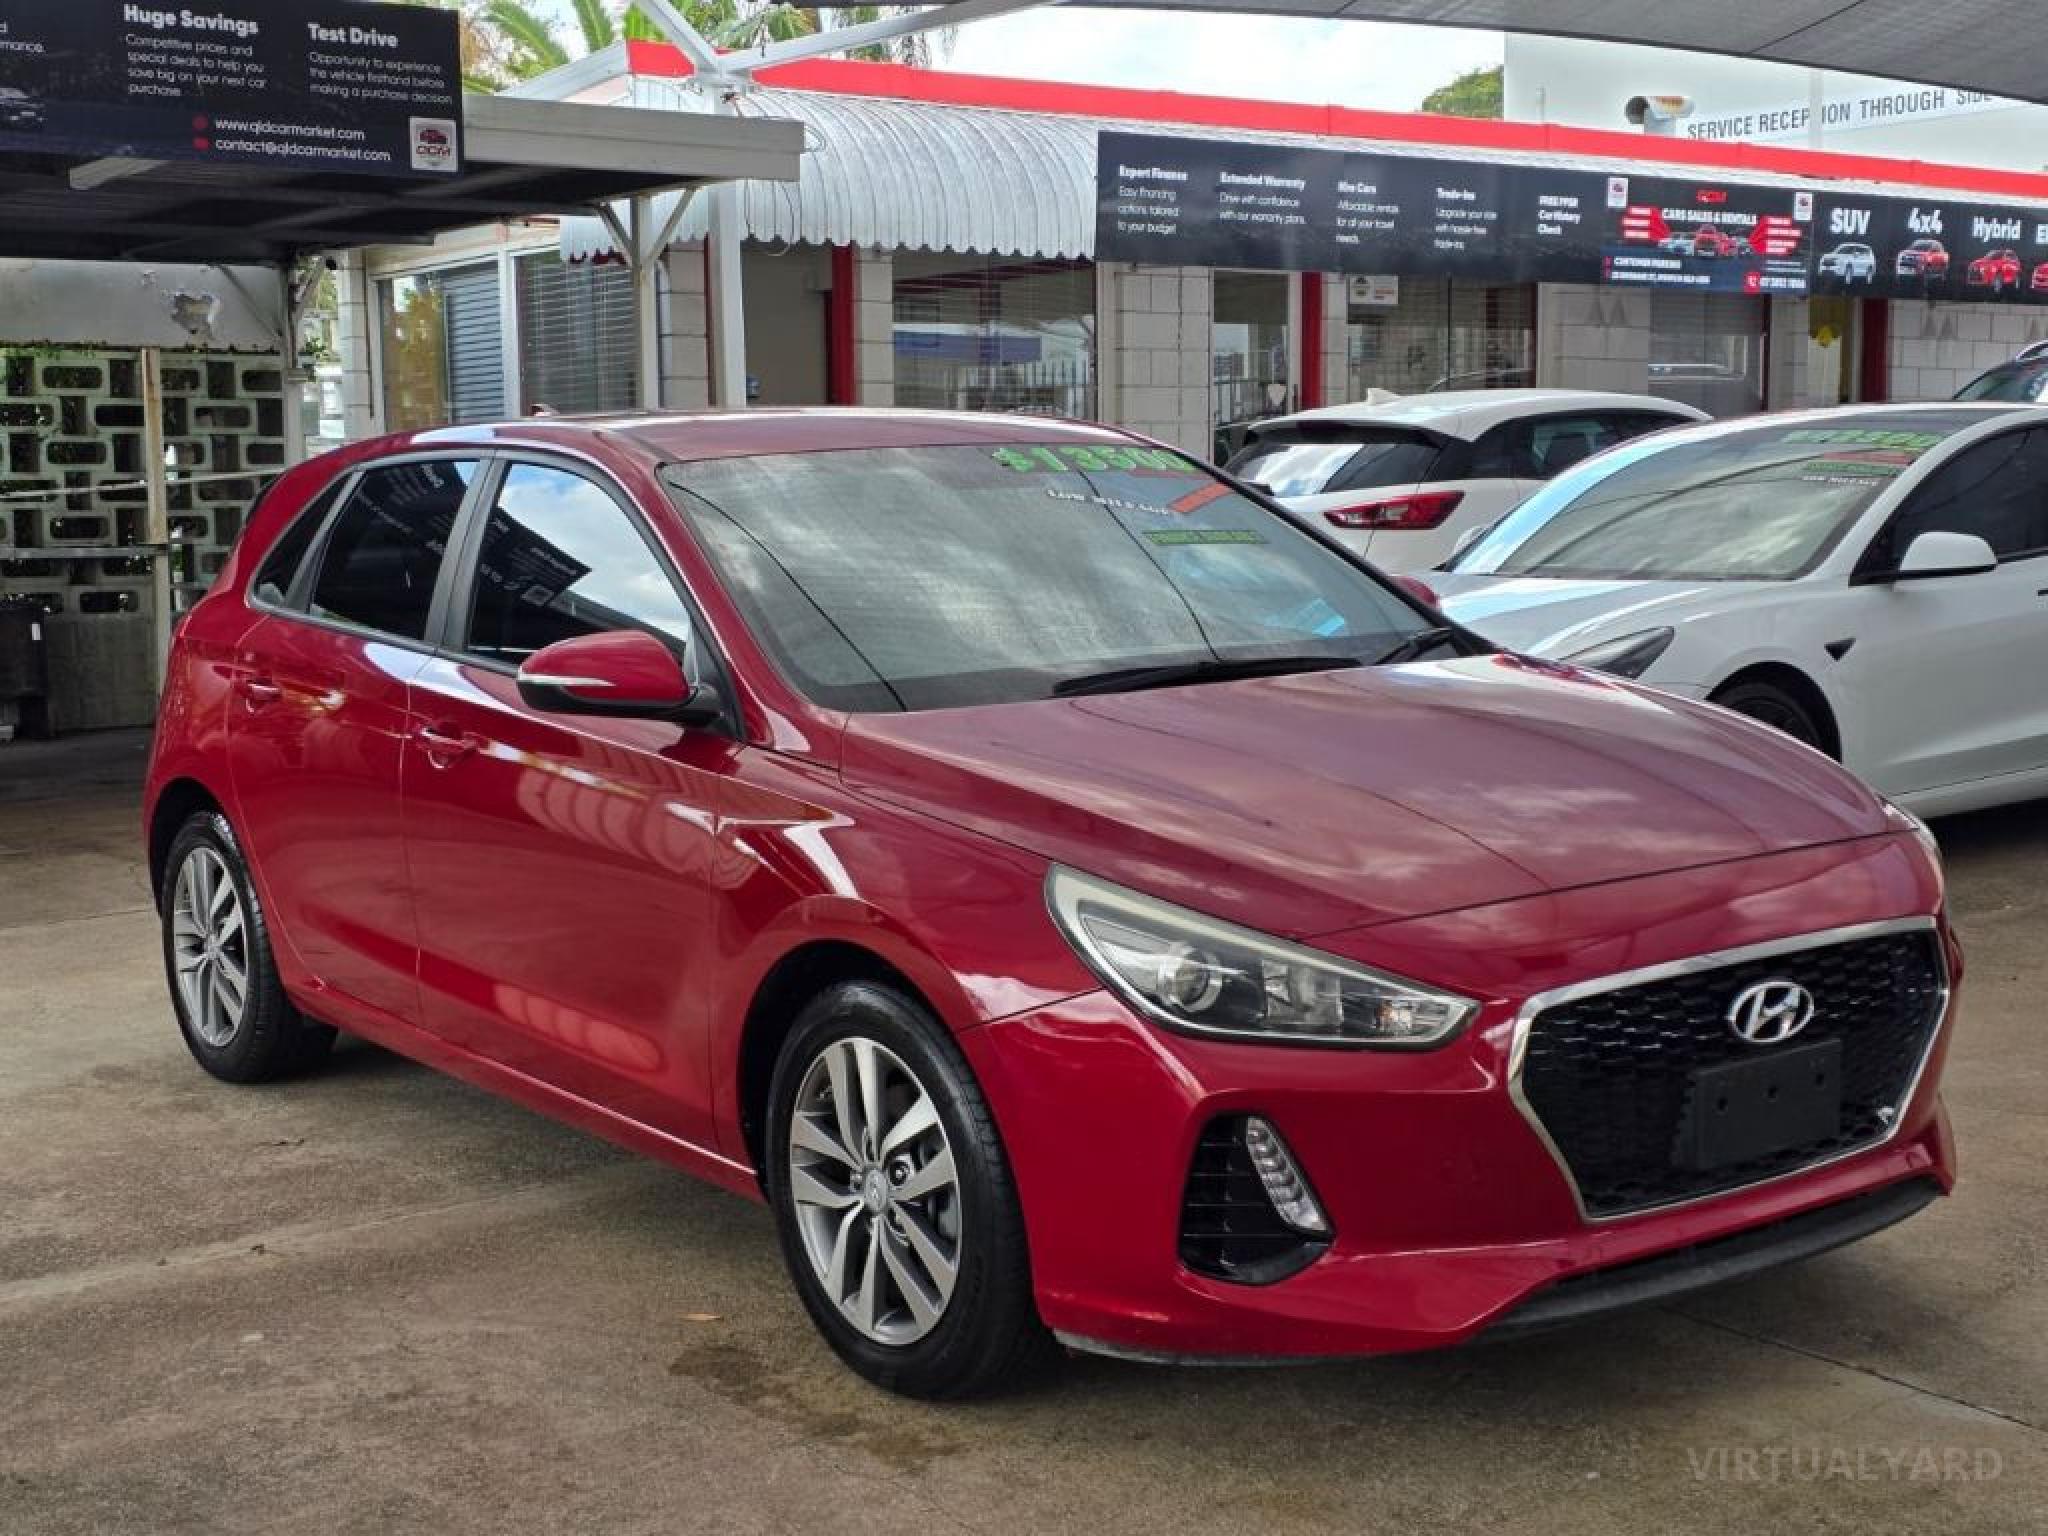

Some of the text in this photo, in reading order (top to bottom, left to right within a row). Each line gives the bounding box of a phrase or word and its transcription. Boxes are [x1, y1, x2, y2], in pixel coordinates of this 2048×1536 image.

[123, 4, 258, 38] Huge Savings
[126, 34, 253, 57] Competitive prices and
[308, 22, 398, 48] Test Drive
[128, 52, 265, 74] special deals to help you
[310, 52, 441, 74] Opportunity to experience
[128, 68, 266, 88] save big on your next car
[310, 68, 445, 88] the vehicle firsthand before
[310, 84, 349, 98] making
[352, 88, 360, 96] a
[362, 90, 408, 101] purchase
[1687, 116, 1753, 140] SERVICE
[1759, 102, 1850, 133] RECEPION
[1860, 89, 1945, 120] THROUGH
[1152, 167, 1188, 182] Finance
[1220, 172, 1306, 192] Extended Warranty
[1119, 186, 1138, 198] Easy
[1662, 207, 1685, 221] CARS
[1829, 207, 1871, 236] SUV
[1907, 207, 1943, 234] 4x4
[1118, 220, 1127, 232] to
[1128, 222, 1145, 234] your
[1972, 216, 2022, 242] Hybrid
